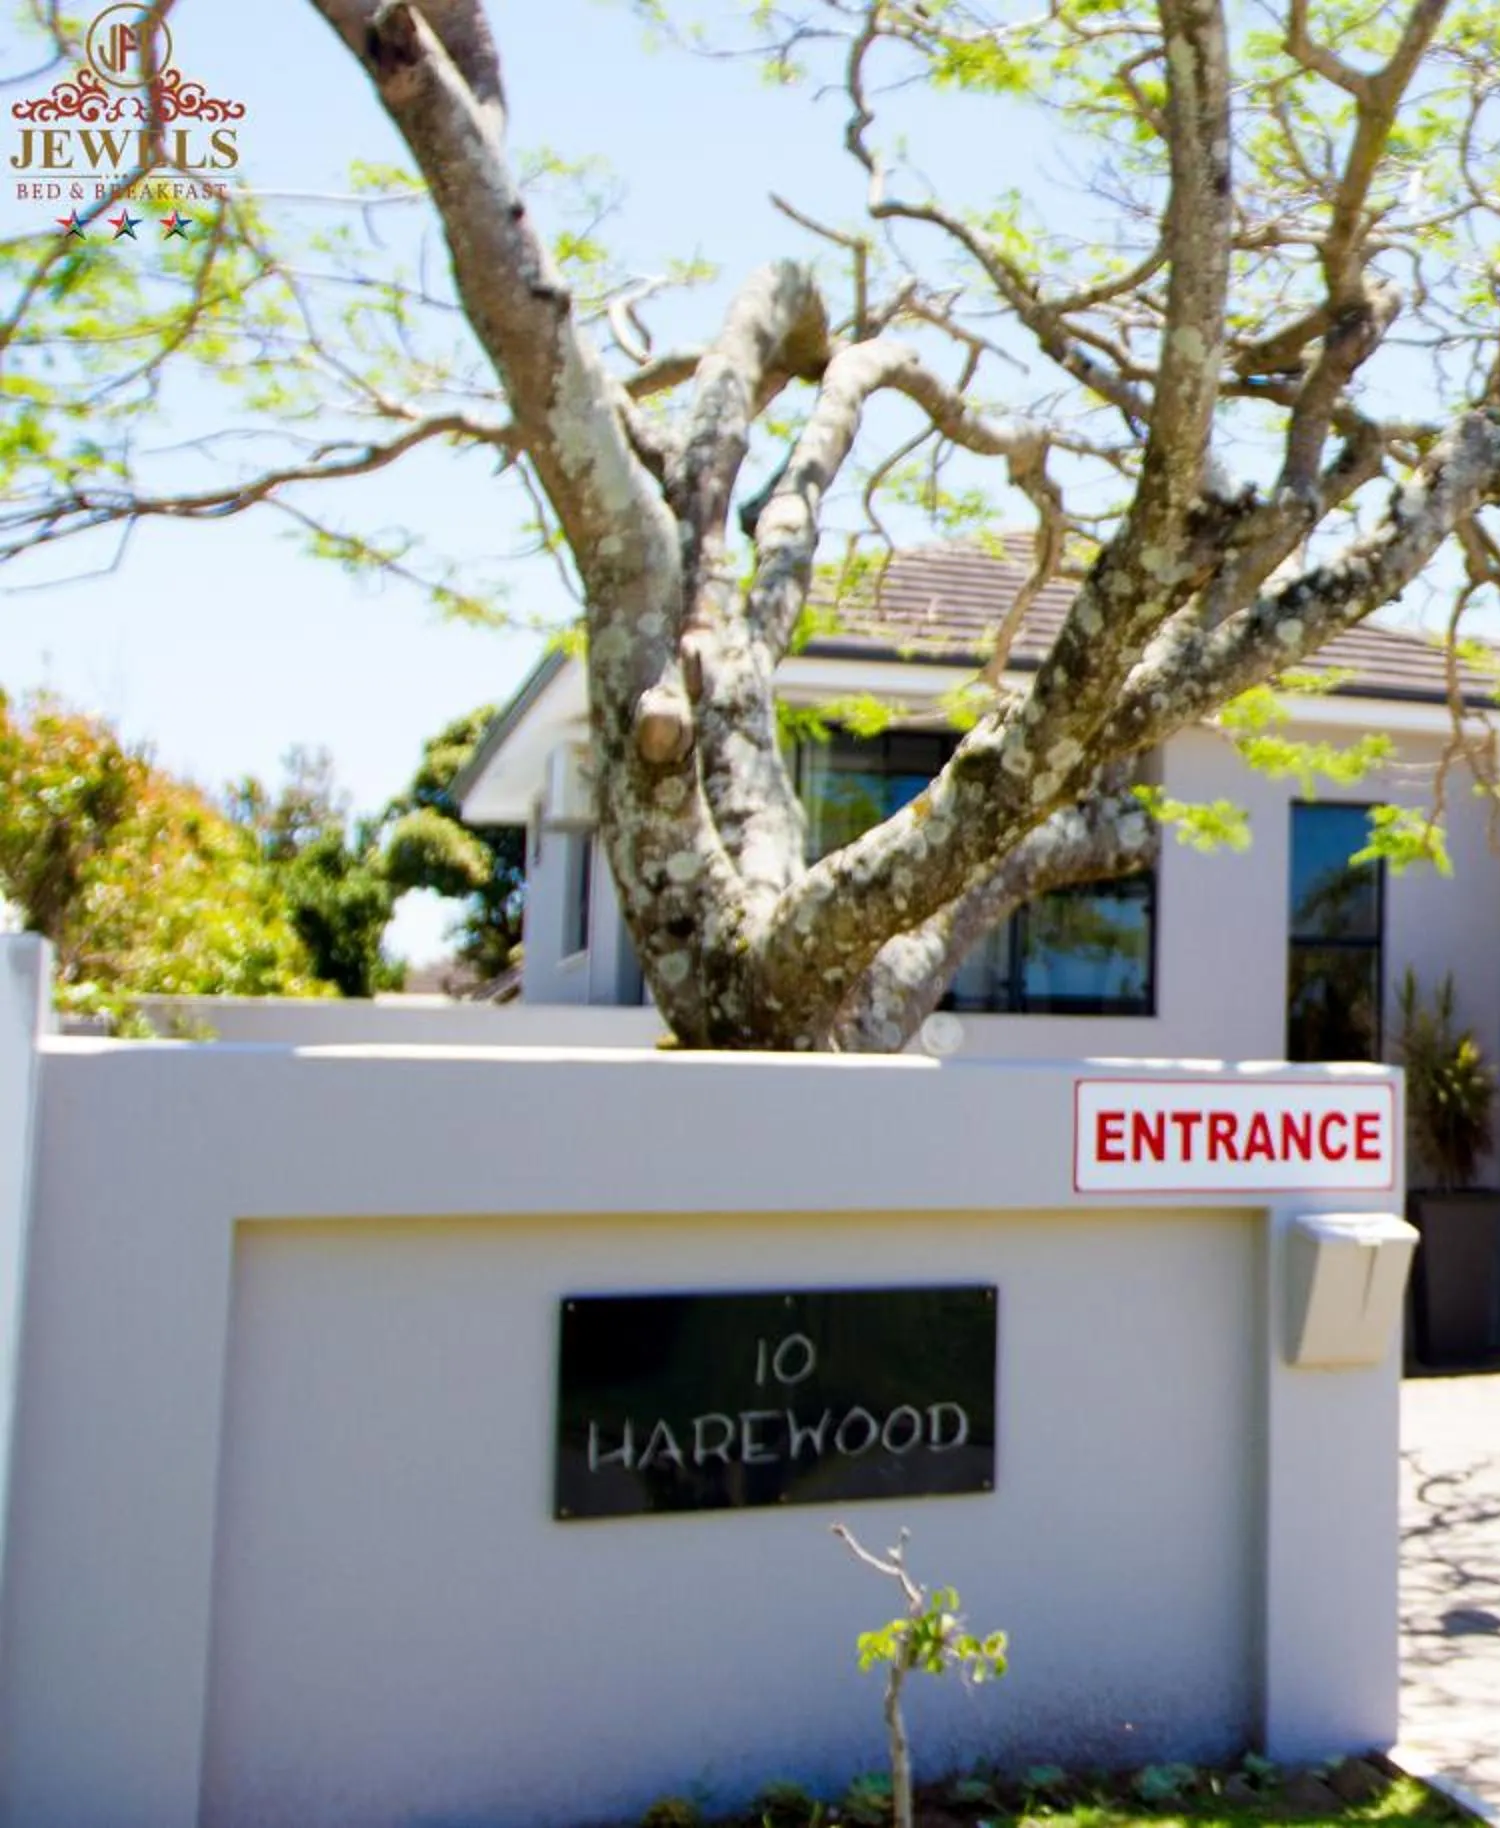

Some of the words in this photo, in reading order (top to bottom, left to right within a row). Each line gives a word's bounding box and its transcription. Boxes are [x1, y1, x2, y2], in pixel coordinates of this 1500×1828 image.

[1095, 1111, 1381, 1162] ENTRANCE
[756, 1333, 816, 1386] 10
[587, 1402, 969, 1473] HAREWOOD
